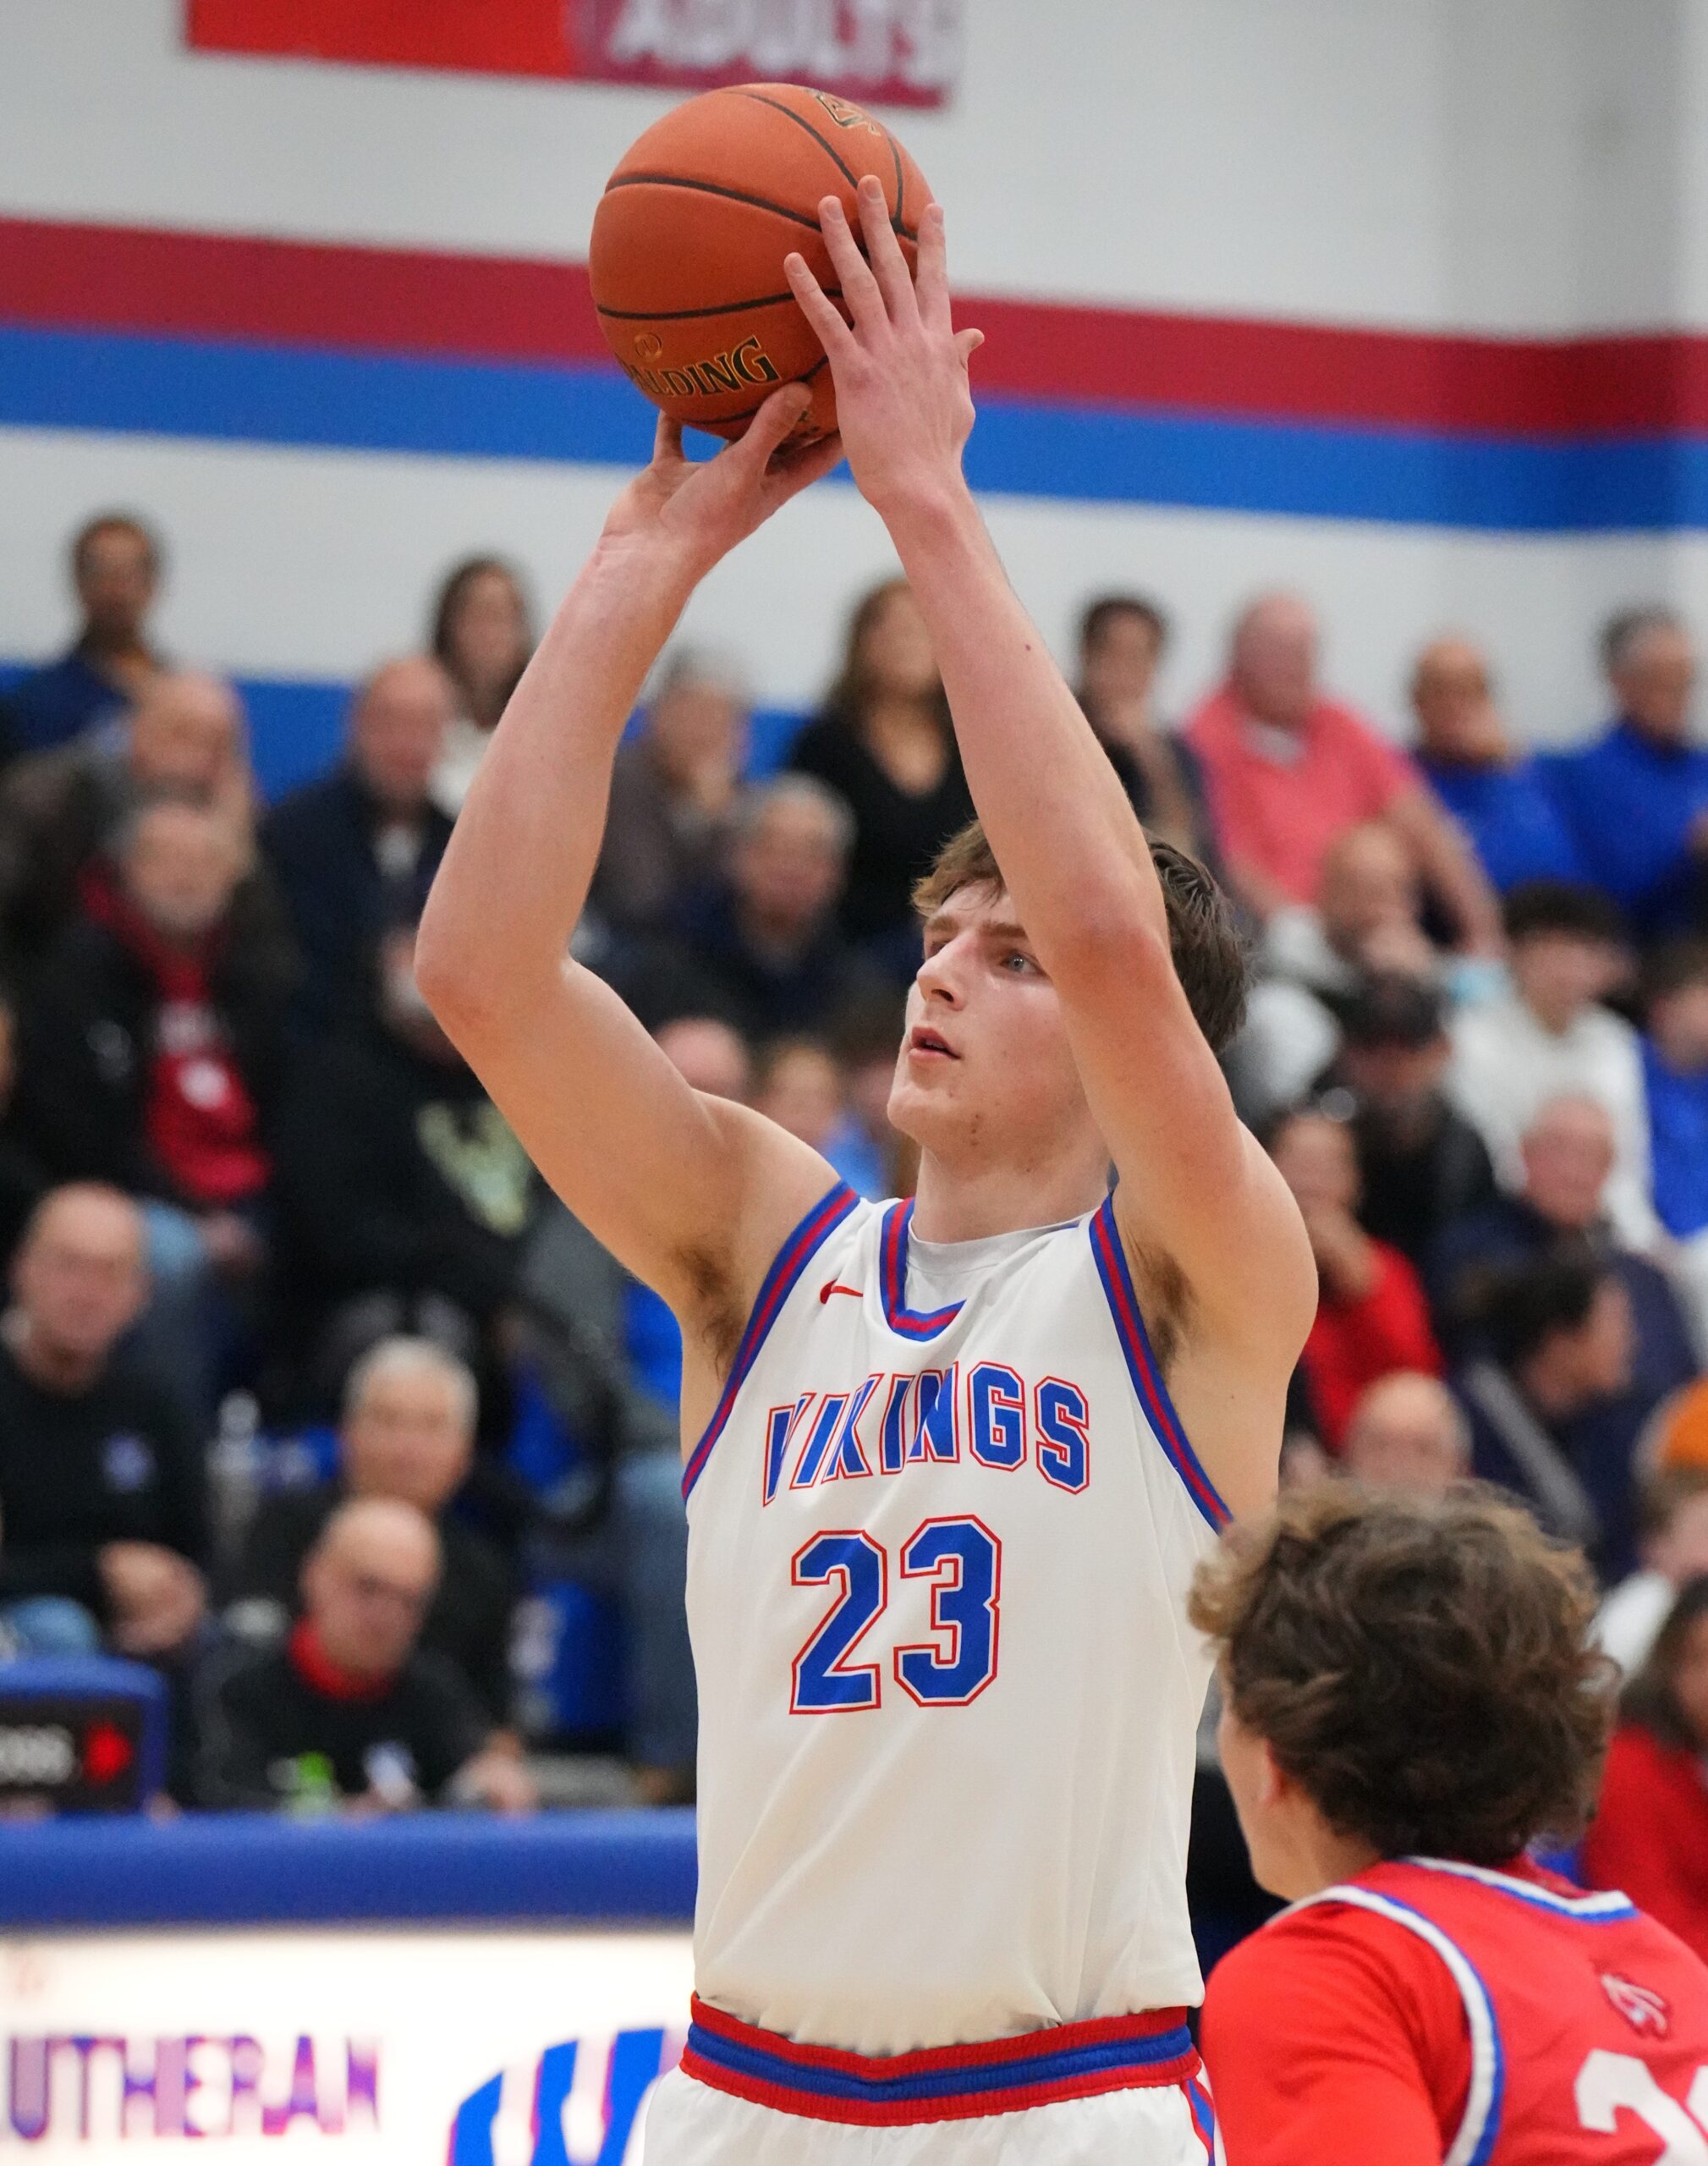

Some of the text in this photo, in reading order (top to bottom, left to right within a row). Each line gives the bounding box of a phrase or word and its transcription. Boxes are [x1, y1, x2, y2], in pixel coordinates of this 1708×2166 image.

[615, 333, 782, 398] ALDING
[763, 1361, 1090, 1507] VIKINGS
[788, 1515, 1002, 1715] 23
[7, 2031, 382, 2141] UTHERAN
